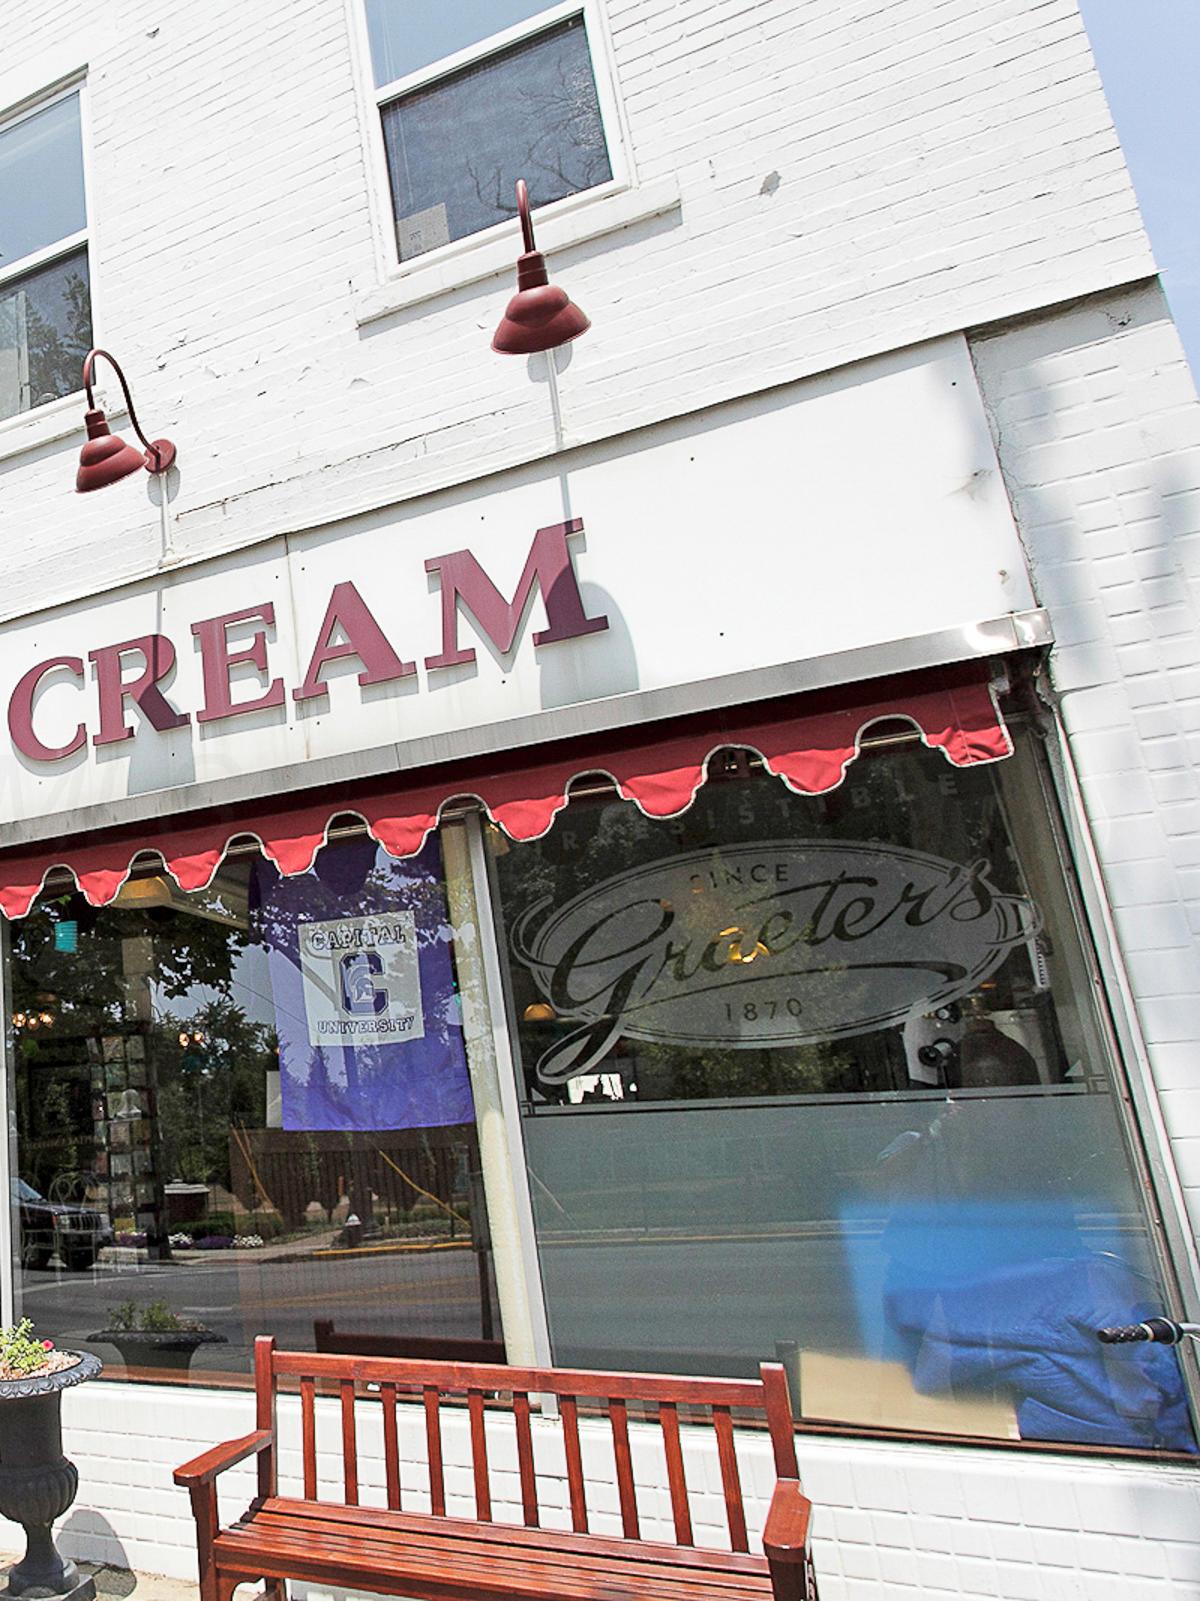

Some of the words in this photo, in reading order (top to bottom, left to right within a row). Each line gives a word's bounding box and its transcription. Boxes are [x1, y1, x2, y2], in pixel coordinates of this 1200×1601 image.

[7, 517, 610, 764] CREAM
[690, 863, 791, 891] SINCE
[311, 925, 406, 950] CAPITAL
[532, 858, 998, 1080] Graeter's
[725, 1000, 804, 1023] 1870
[317, 1016, 415, 1035] UNIVERSITY
